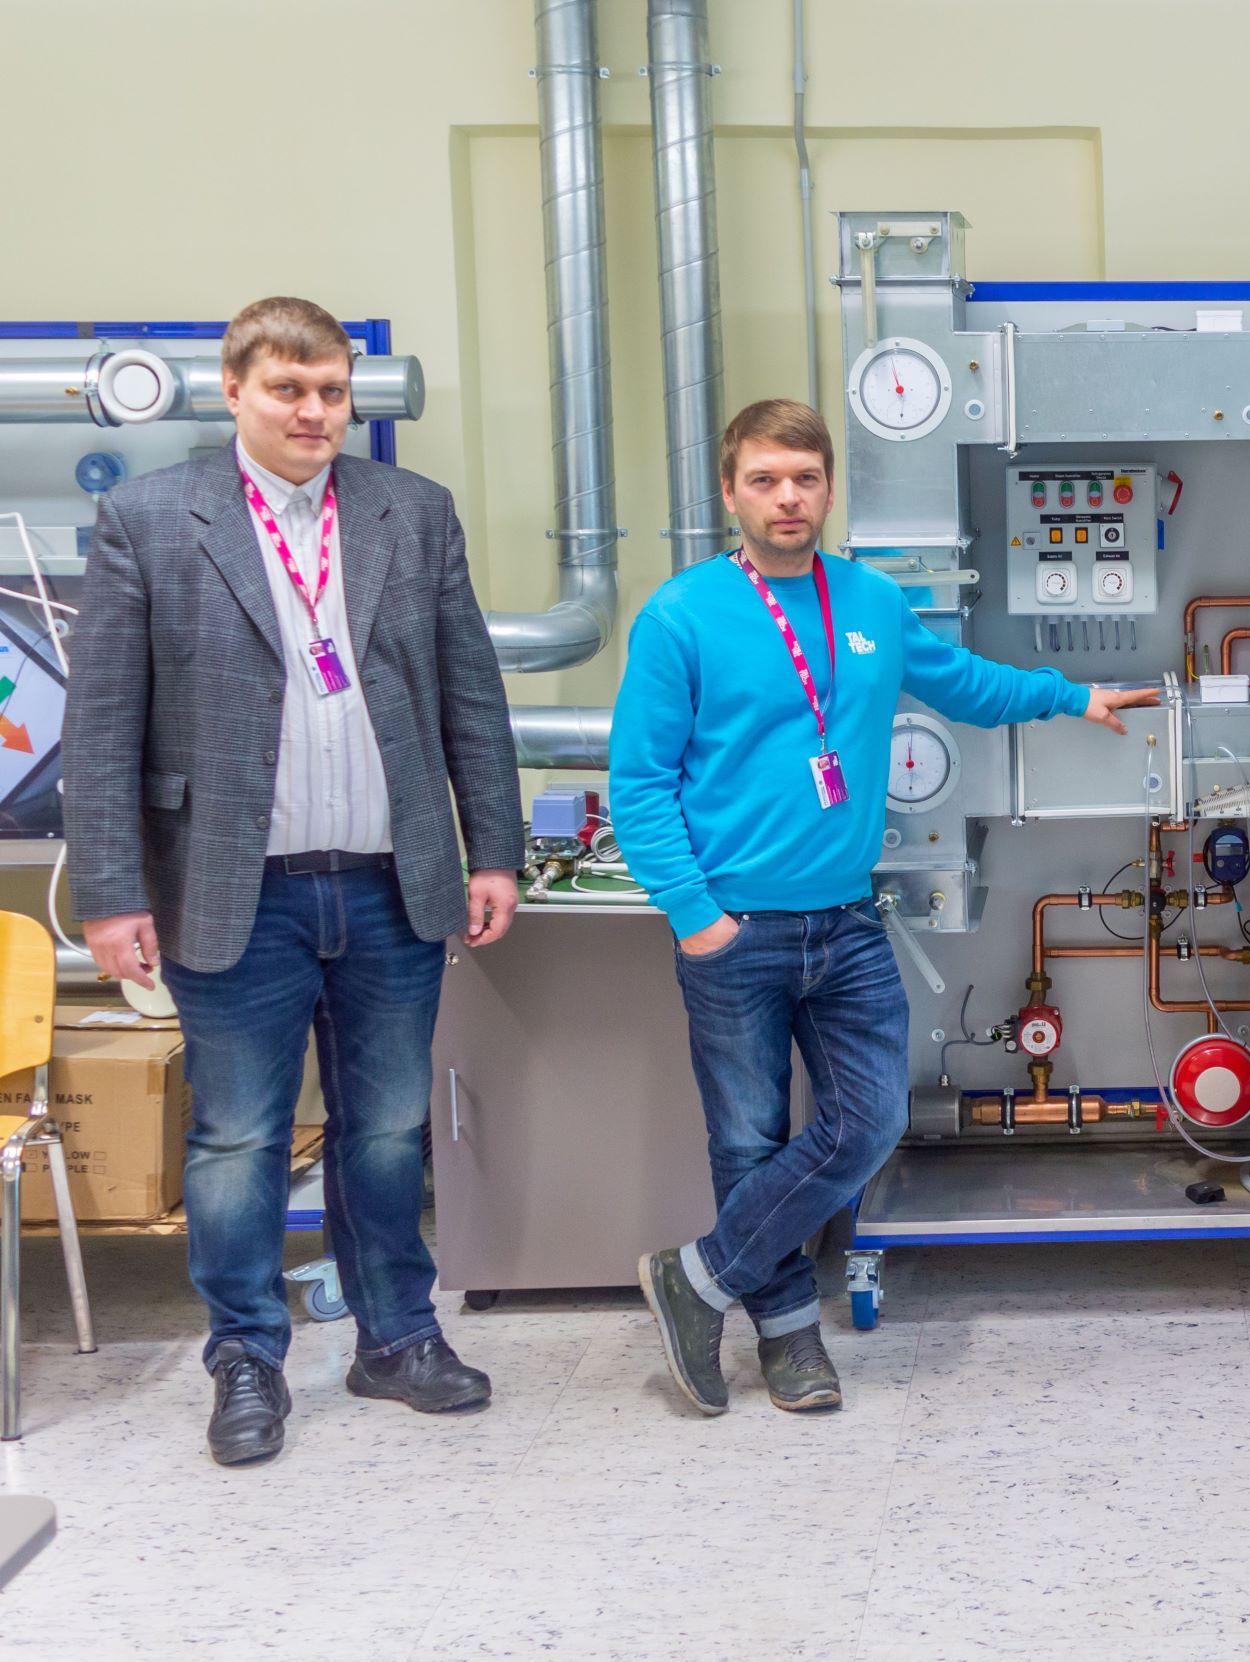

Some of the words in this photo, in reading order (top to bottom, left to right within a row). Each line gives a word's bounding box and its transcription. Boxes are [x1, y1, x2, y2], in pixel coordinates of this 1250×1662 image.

[845, 631, 866, 643] TAL
[848, 640, 876, 653] TECH
[55, 1093, 93, 1104] MASK
